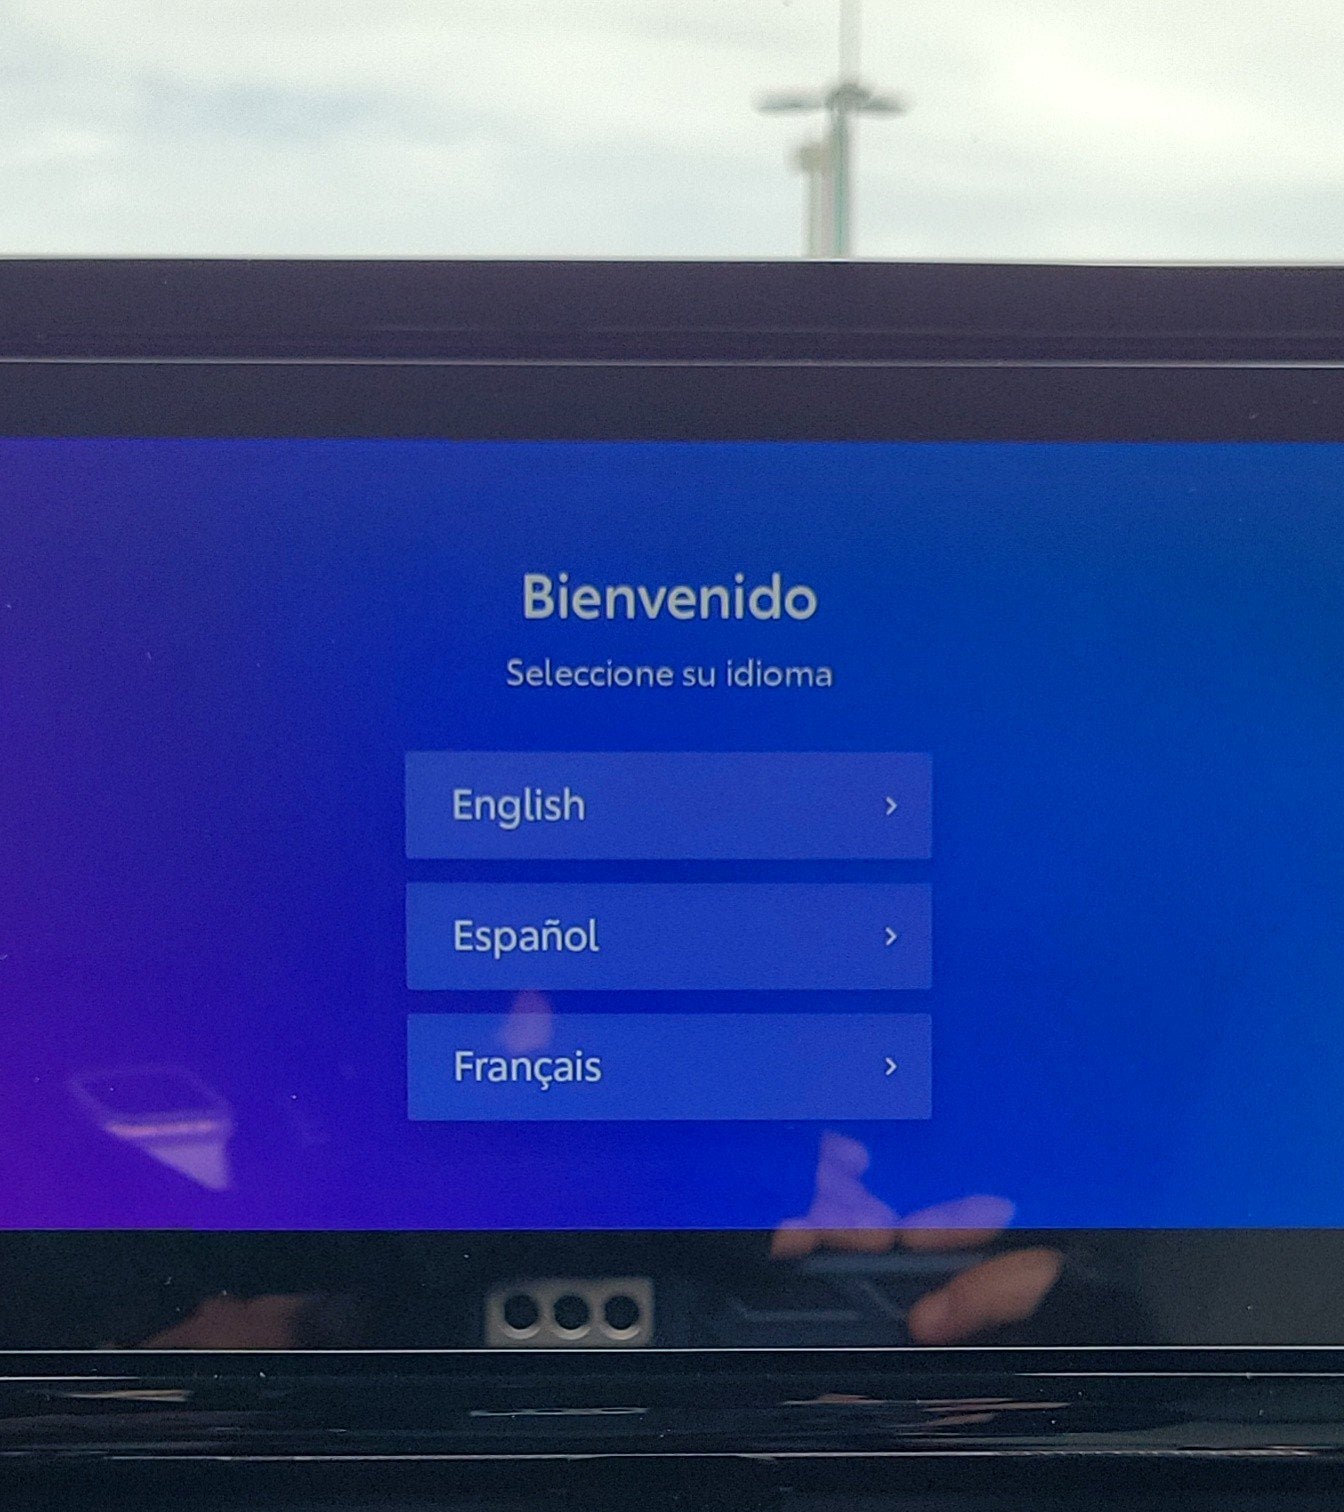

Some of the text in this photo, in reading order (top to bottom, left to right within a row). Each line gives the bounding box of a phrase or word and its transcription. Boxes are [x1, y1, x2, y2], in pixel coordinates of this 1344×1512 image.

[523, 572, 819, 620] Bienvenido
[506, 658, 834, 687] Seleccione su idioma
[452, 788, 587, 830] English
[453, 919, 599, 960] Español
[454, 1050, 603, 1092] Français
